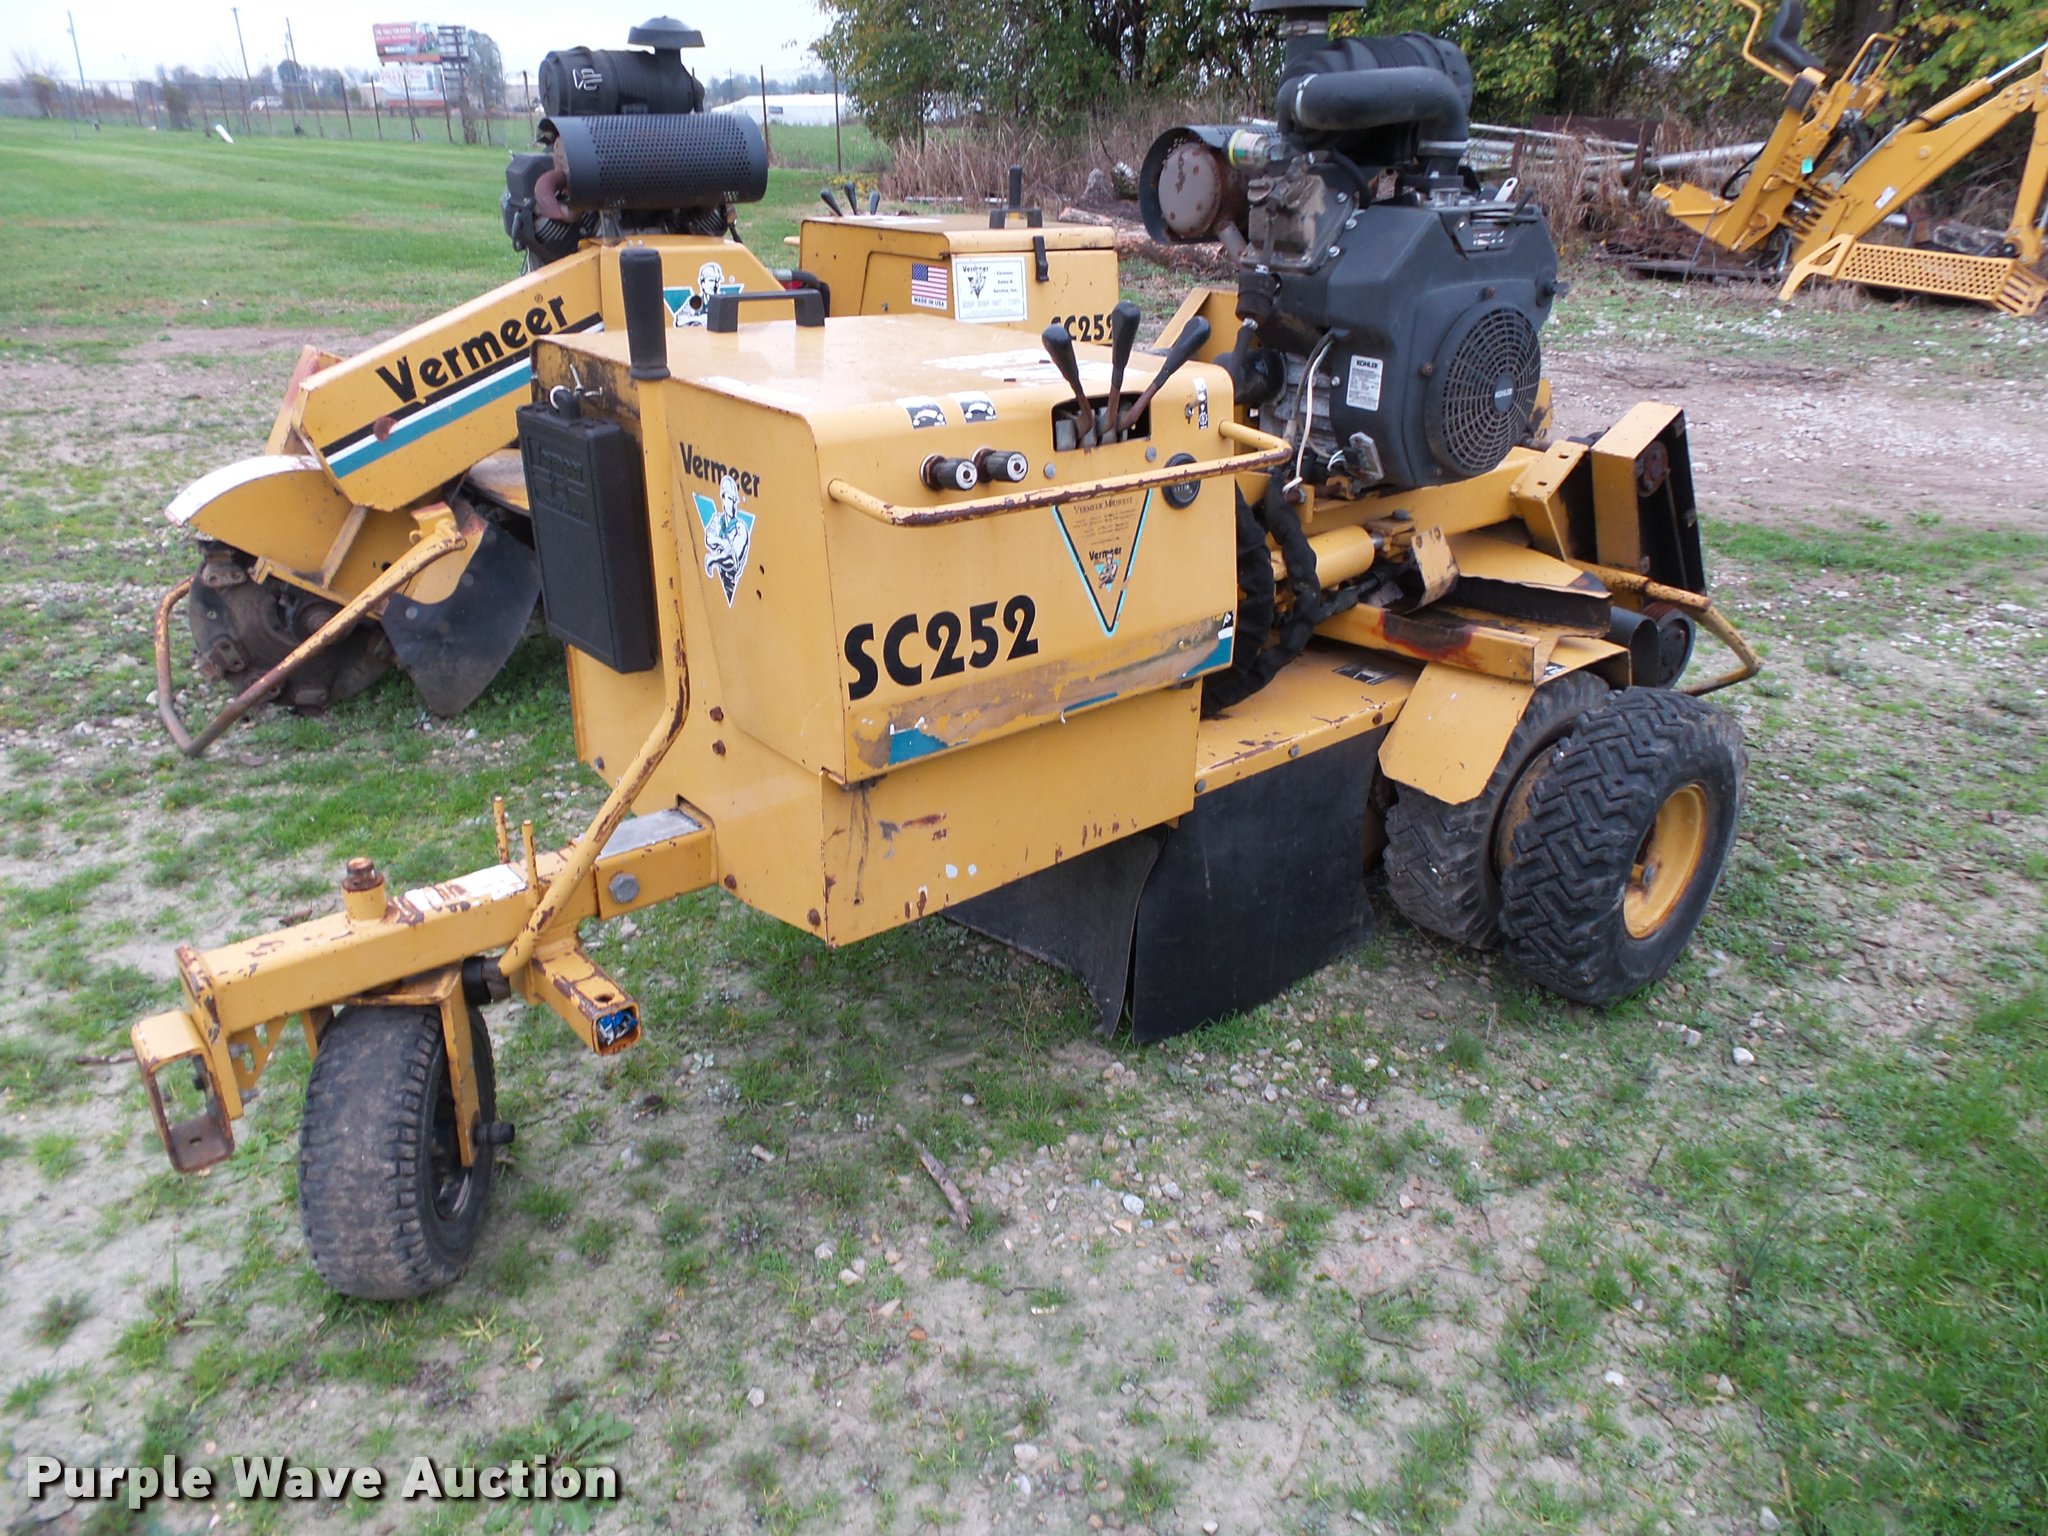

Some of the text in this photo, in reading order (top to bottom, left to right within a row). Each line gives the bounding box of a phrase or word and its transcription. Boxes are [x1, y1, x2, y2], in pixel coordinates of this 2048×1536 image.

[375, 295, 568, 403] Vermeer
[1356, 360, 1378, 368] KOHLER
[679, 441, 760, 498] Vermeer
[1089, 546, 1122, 560] Vermeer
[844, 594, 1039, 701] SC252
